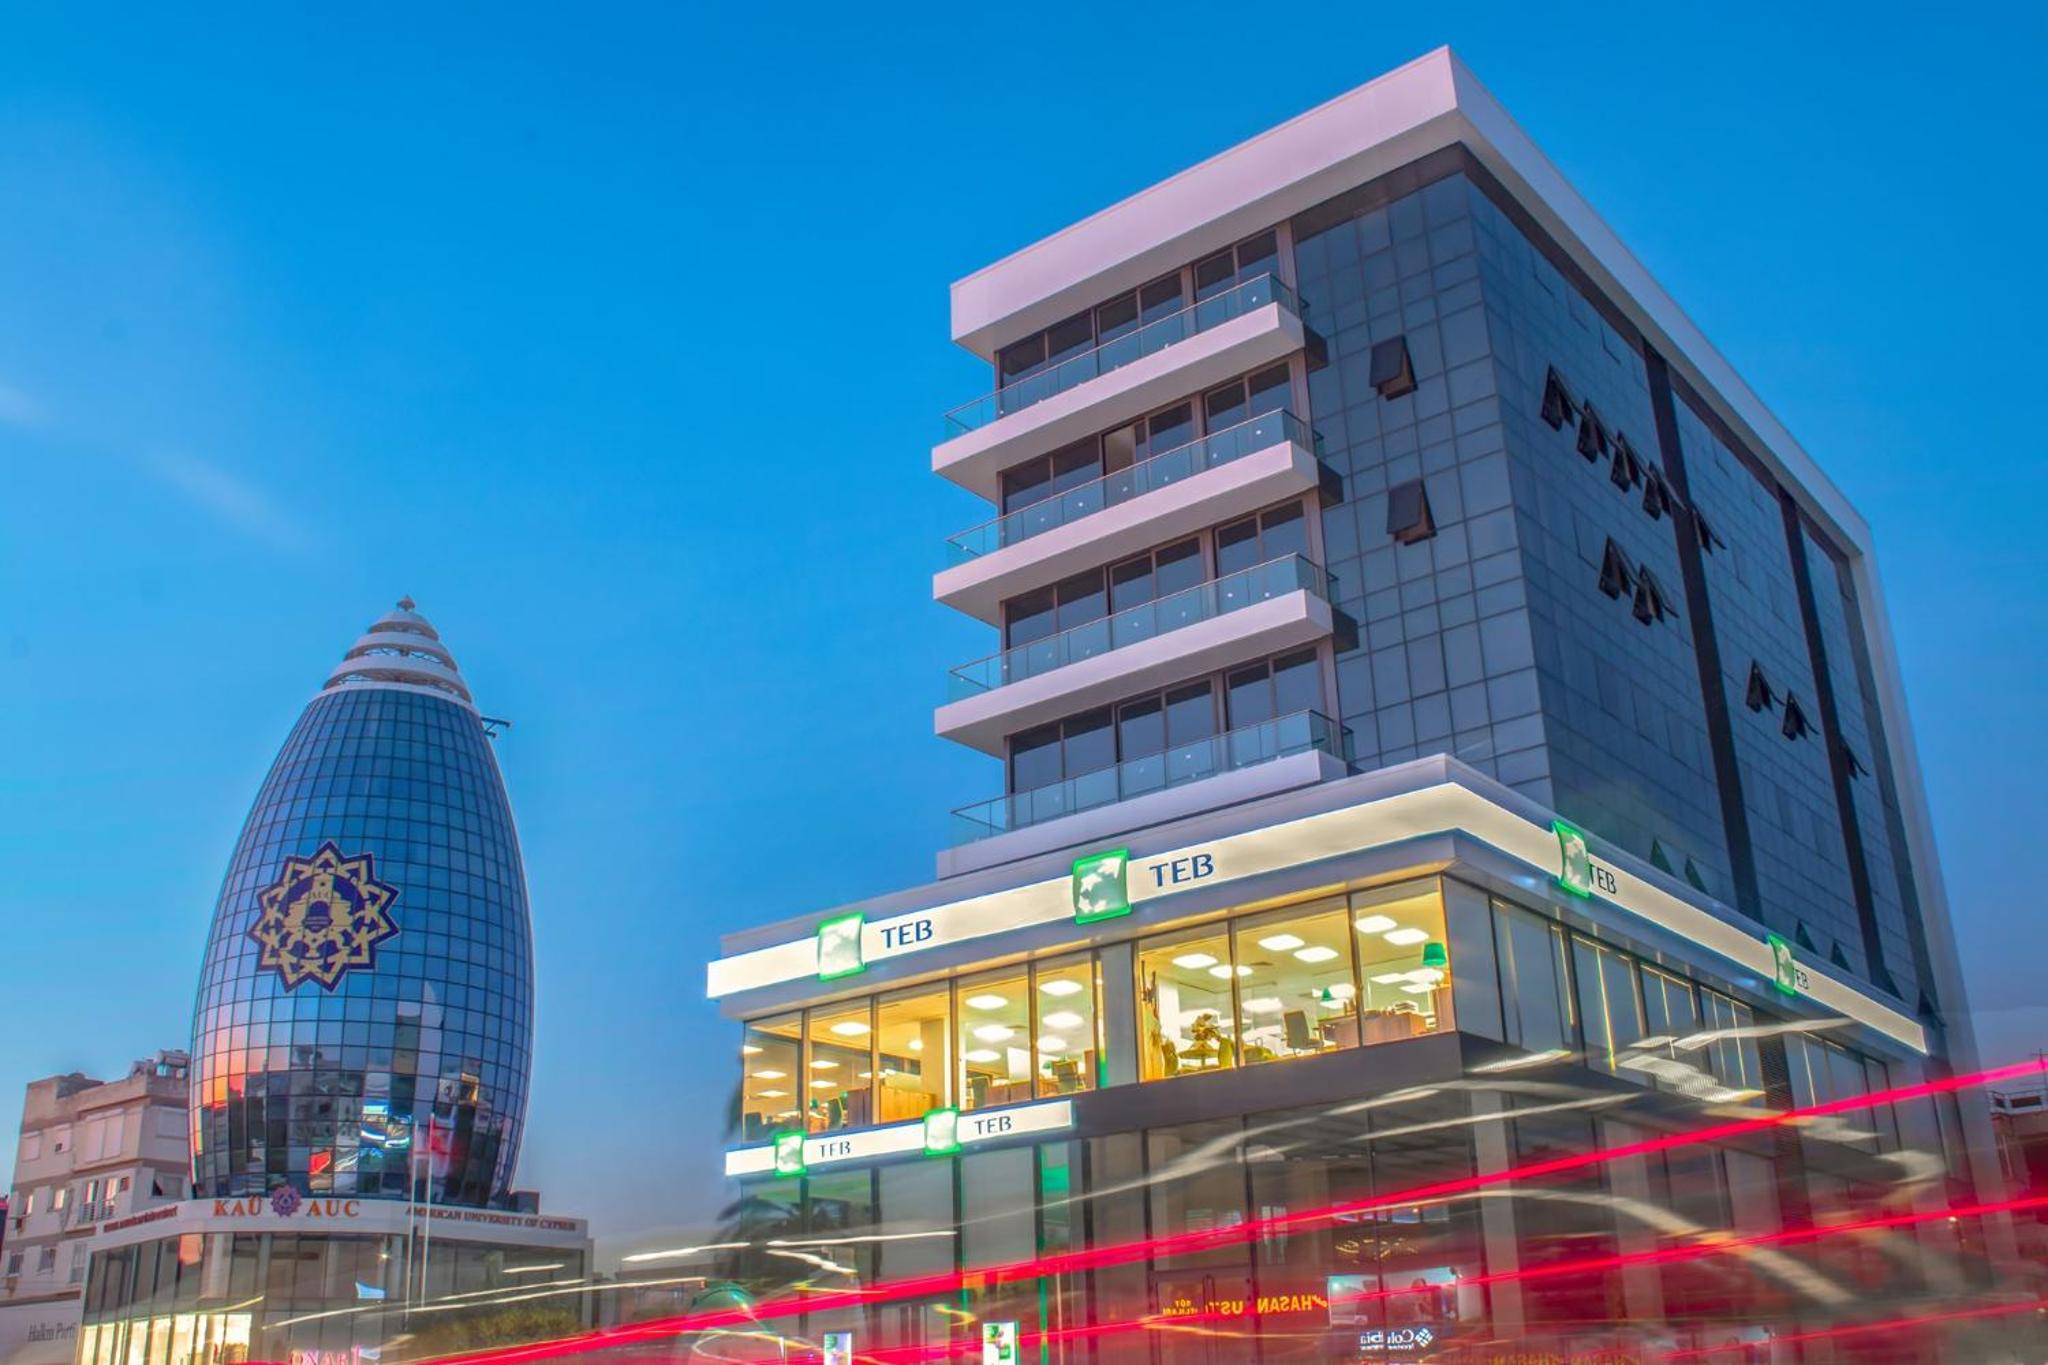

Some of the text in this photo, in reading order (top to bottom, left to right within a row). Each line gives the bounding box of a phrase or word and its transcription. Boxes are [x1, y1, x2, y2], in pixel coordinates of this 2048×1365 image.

[1149, 853, 1214, 887] TEB
[1589, 863, 1617, 895] TEB
[880, 919, 933, 949] TEB
[1793, 967, 1809, 990] EB
[974, 1116, 1013, 1136] TEB
[819, 1141, 851, 1158] TEB
[212, 1194, 360, 1218] KAÜ AUC
[464, 1212, 523, 1227] UNIVERSITY
[525, 1217, 538, 1228] OF
